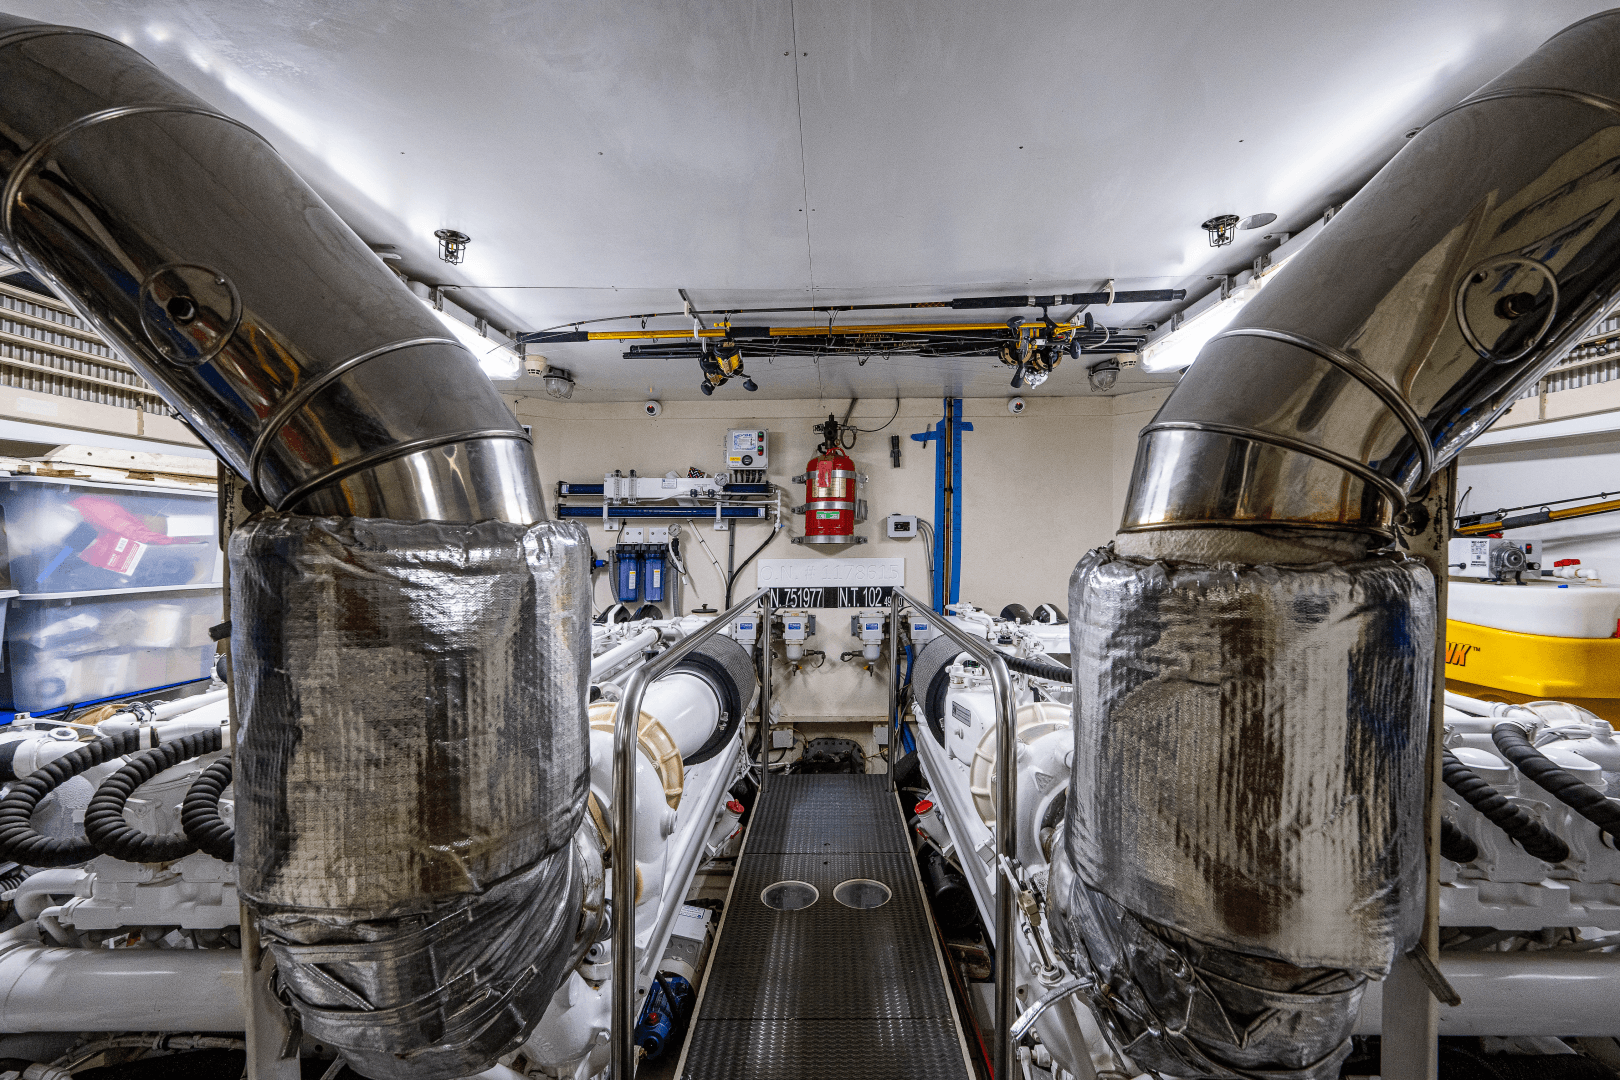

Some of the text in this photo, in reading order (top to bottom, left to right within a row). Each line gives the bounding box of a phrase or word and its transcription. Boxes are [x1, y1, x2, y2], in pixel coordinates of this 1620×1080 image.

[760, 565, 799, 582] O.N.
[822, 564, 900, 581] 1178615
[784, 588, 823, 608] 751977
[839, 587, 860, 608] N.T.
[863, 587, 882, 607] 102
